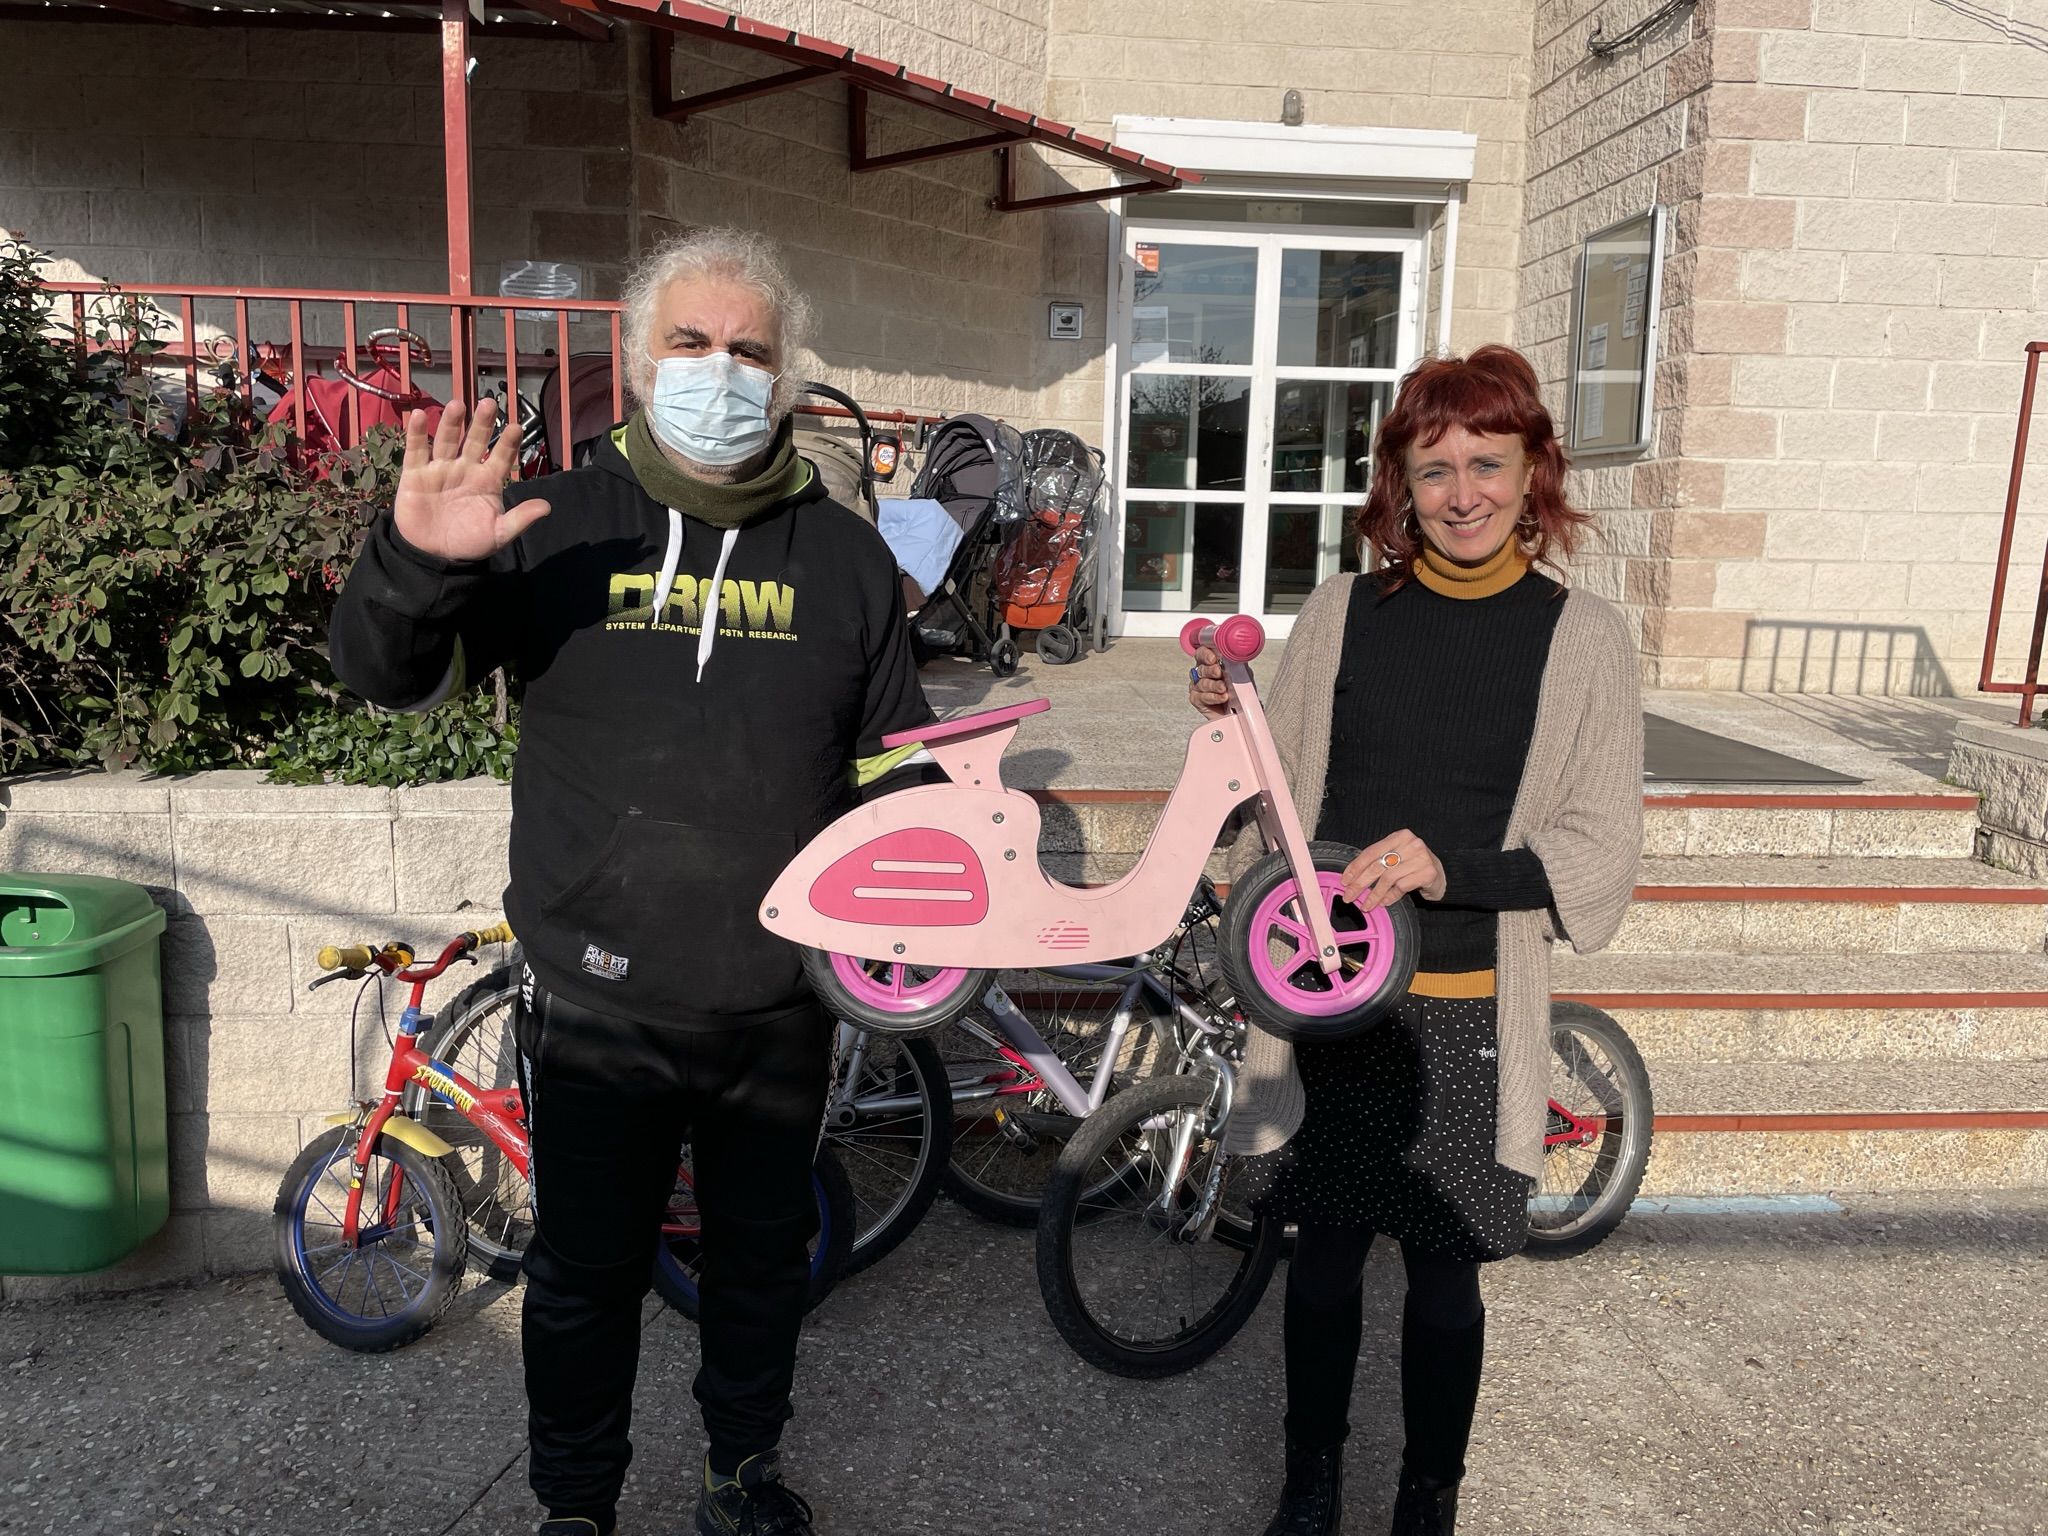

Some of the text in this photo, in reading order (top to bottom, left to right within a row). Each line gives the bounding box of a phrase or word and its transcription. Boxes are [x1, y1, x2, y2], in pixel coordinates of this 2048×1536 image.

[607, 571, 795, 631] DRAW
[605, 622, 798, 641] SYSTEM DEPARTME PSTN RESEARCH
